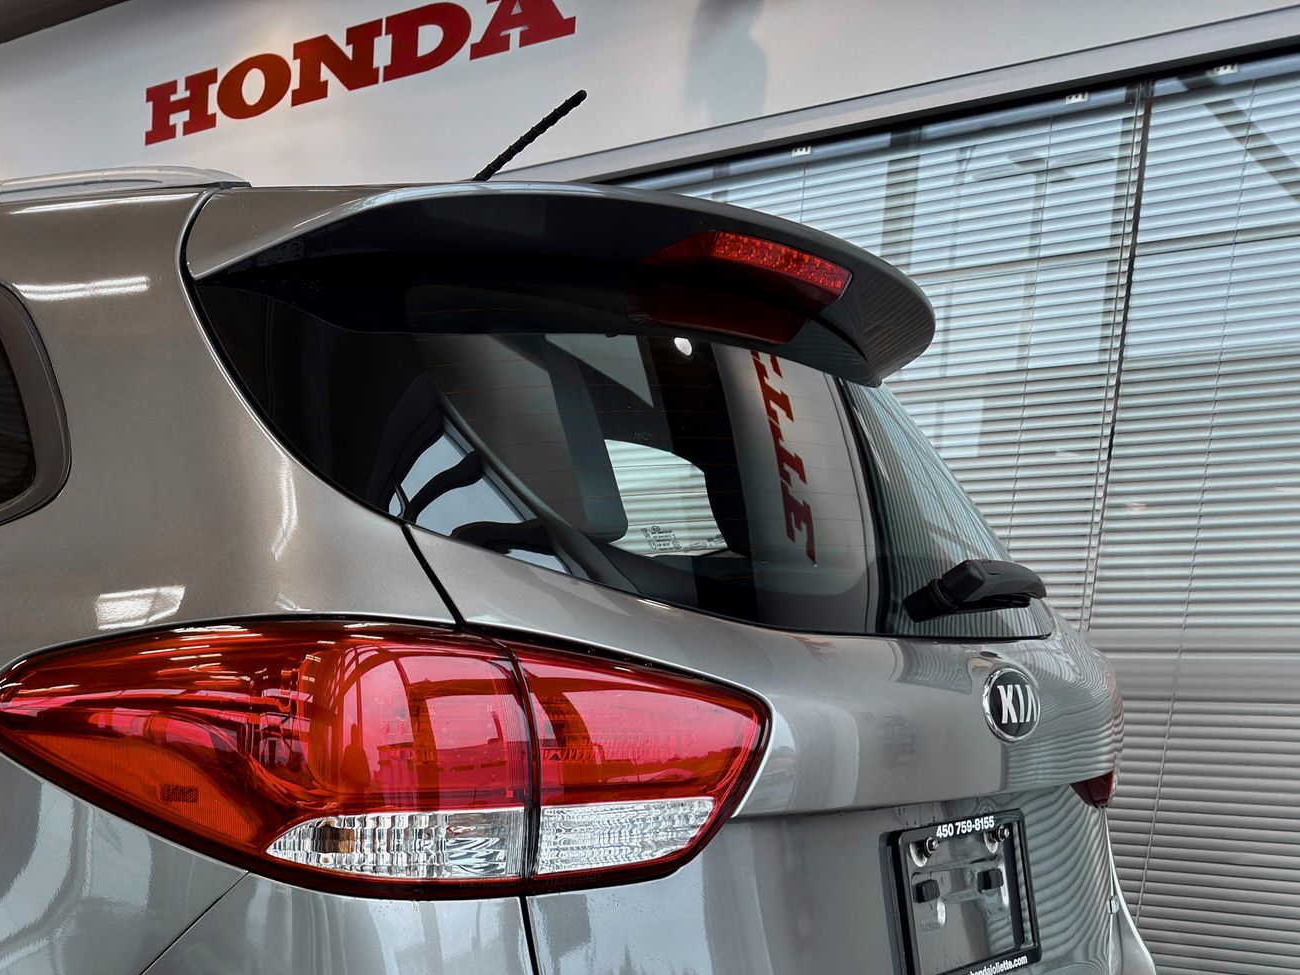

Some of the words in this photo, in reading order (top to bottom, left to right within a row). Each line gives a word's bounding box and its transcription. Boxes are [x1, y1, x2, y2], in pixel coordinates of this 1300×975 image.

[145, 0, 576, 145] HONDA
[996, 683, 1038, 724] KIA
[935, 822, 955, 839] 450
[954, 815, 995, 835] 759-8155
